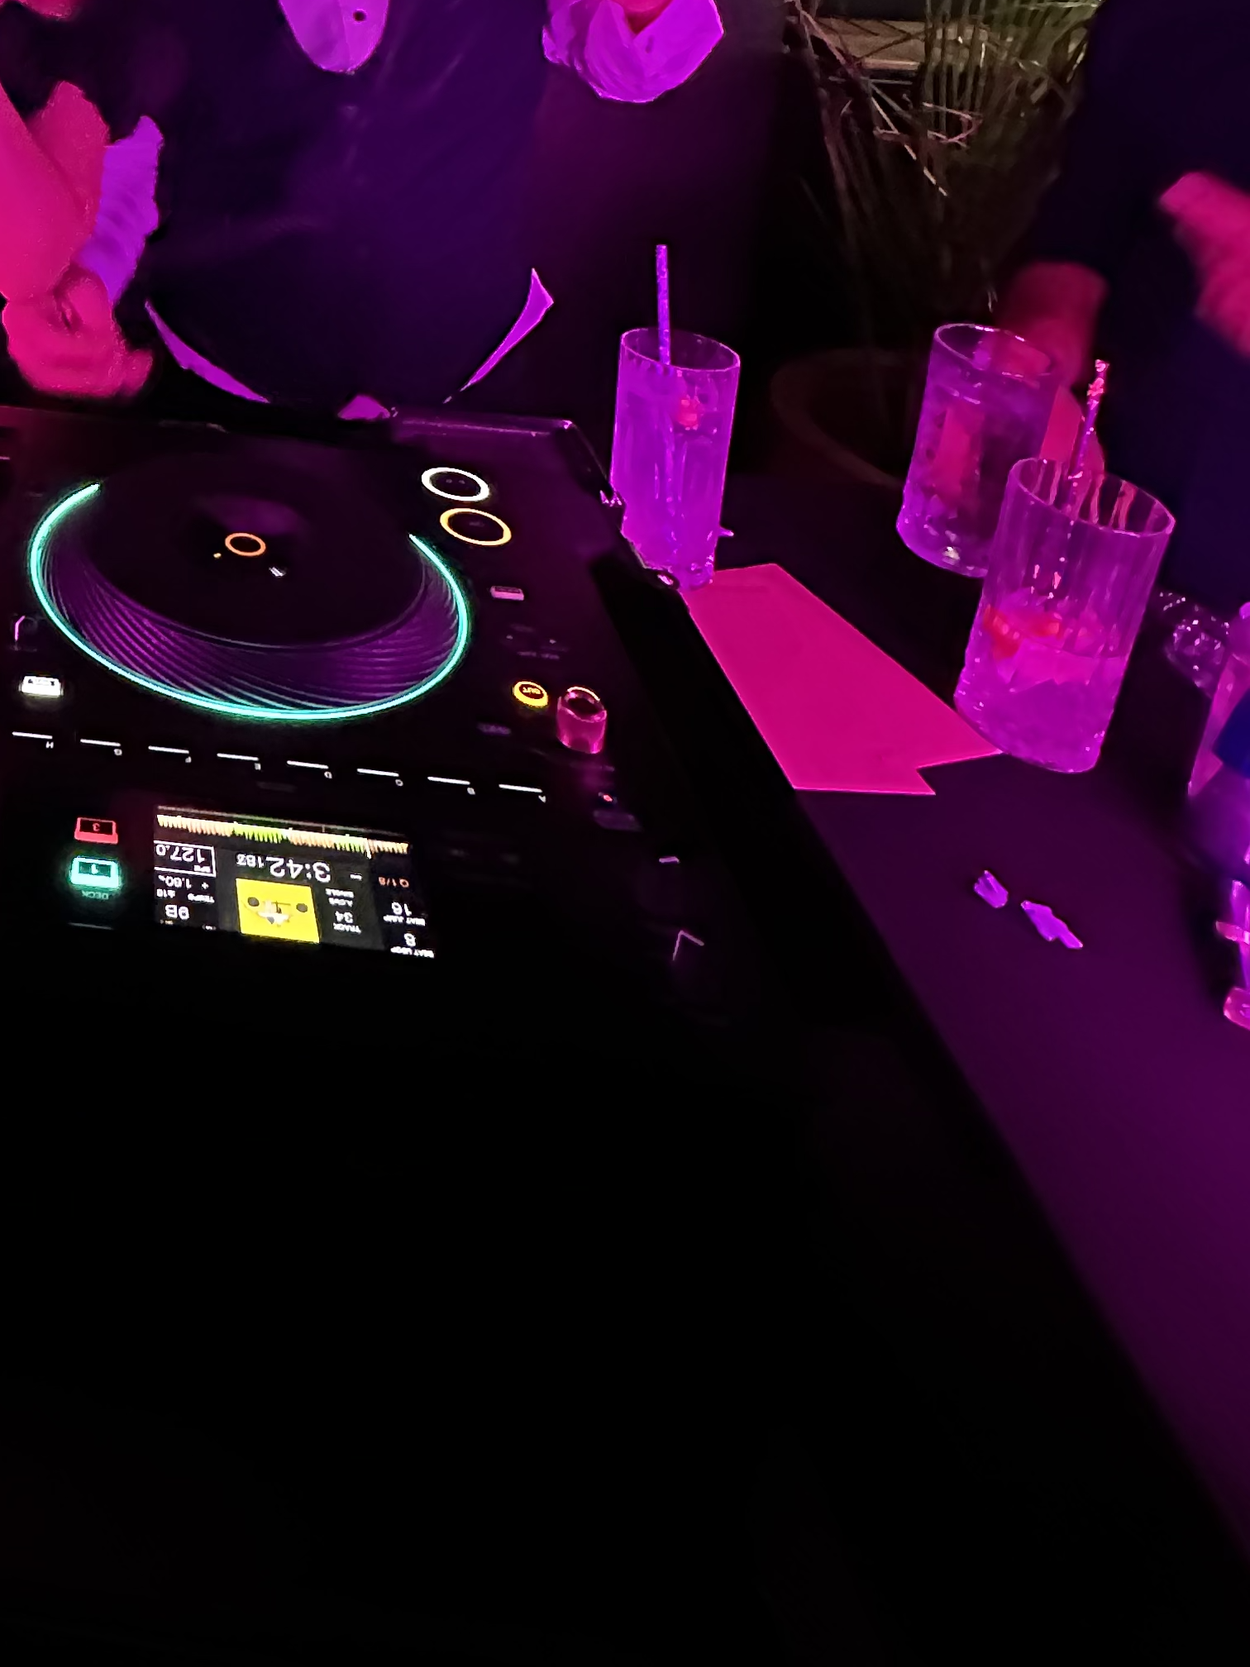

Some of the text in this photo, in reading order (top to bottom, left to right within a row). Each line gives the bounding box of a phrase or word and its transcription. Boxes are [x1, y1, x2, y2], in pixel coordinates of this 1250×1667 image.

[92, 822, 100, 831] 3
[155, 843, 205, 863] 127.0
[91, 864, 99, 874] 1
[82, 890, 109, 900] DECK
[187, 893, 215, 904] TEMPO
[164, 904, 190, 920] 9B
[391, 902, 412, 916] 16
[335, 911, 353, 923] 34
[333, 923, 362, 934] TRACK
[404, 933, 416, 947] 8
